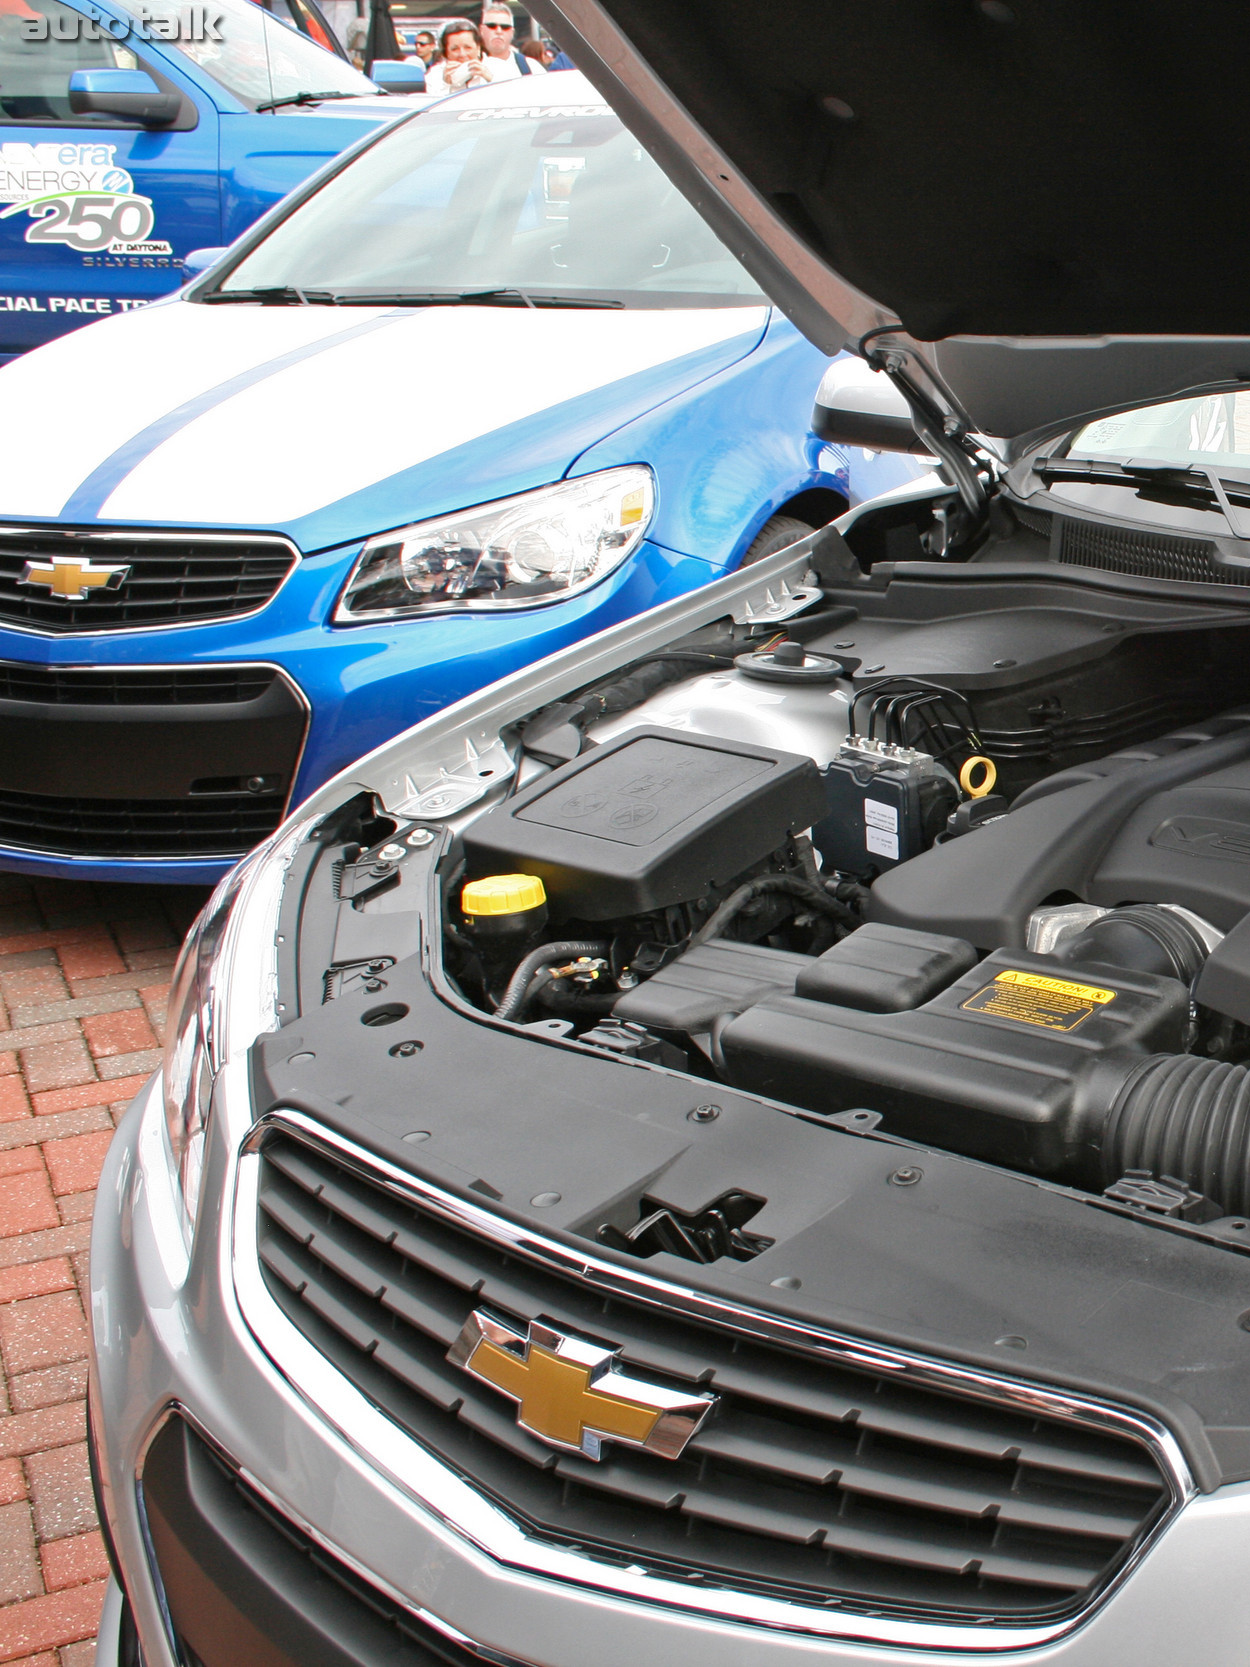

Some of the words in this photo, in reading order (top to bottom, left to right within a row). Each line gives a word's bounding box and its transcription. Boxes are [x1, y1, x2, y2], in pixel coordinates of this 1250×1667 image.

[32, 197, 151, 247] 250
[112, 244, 123, 252] AT
[126, 244, 168, 252] DAYTONA
[48, 297, 112, 314] PACE
[1025, 977, 1088, 994] CAUTION!
